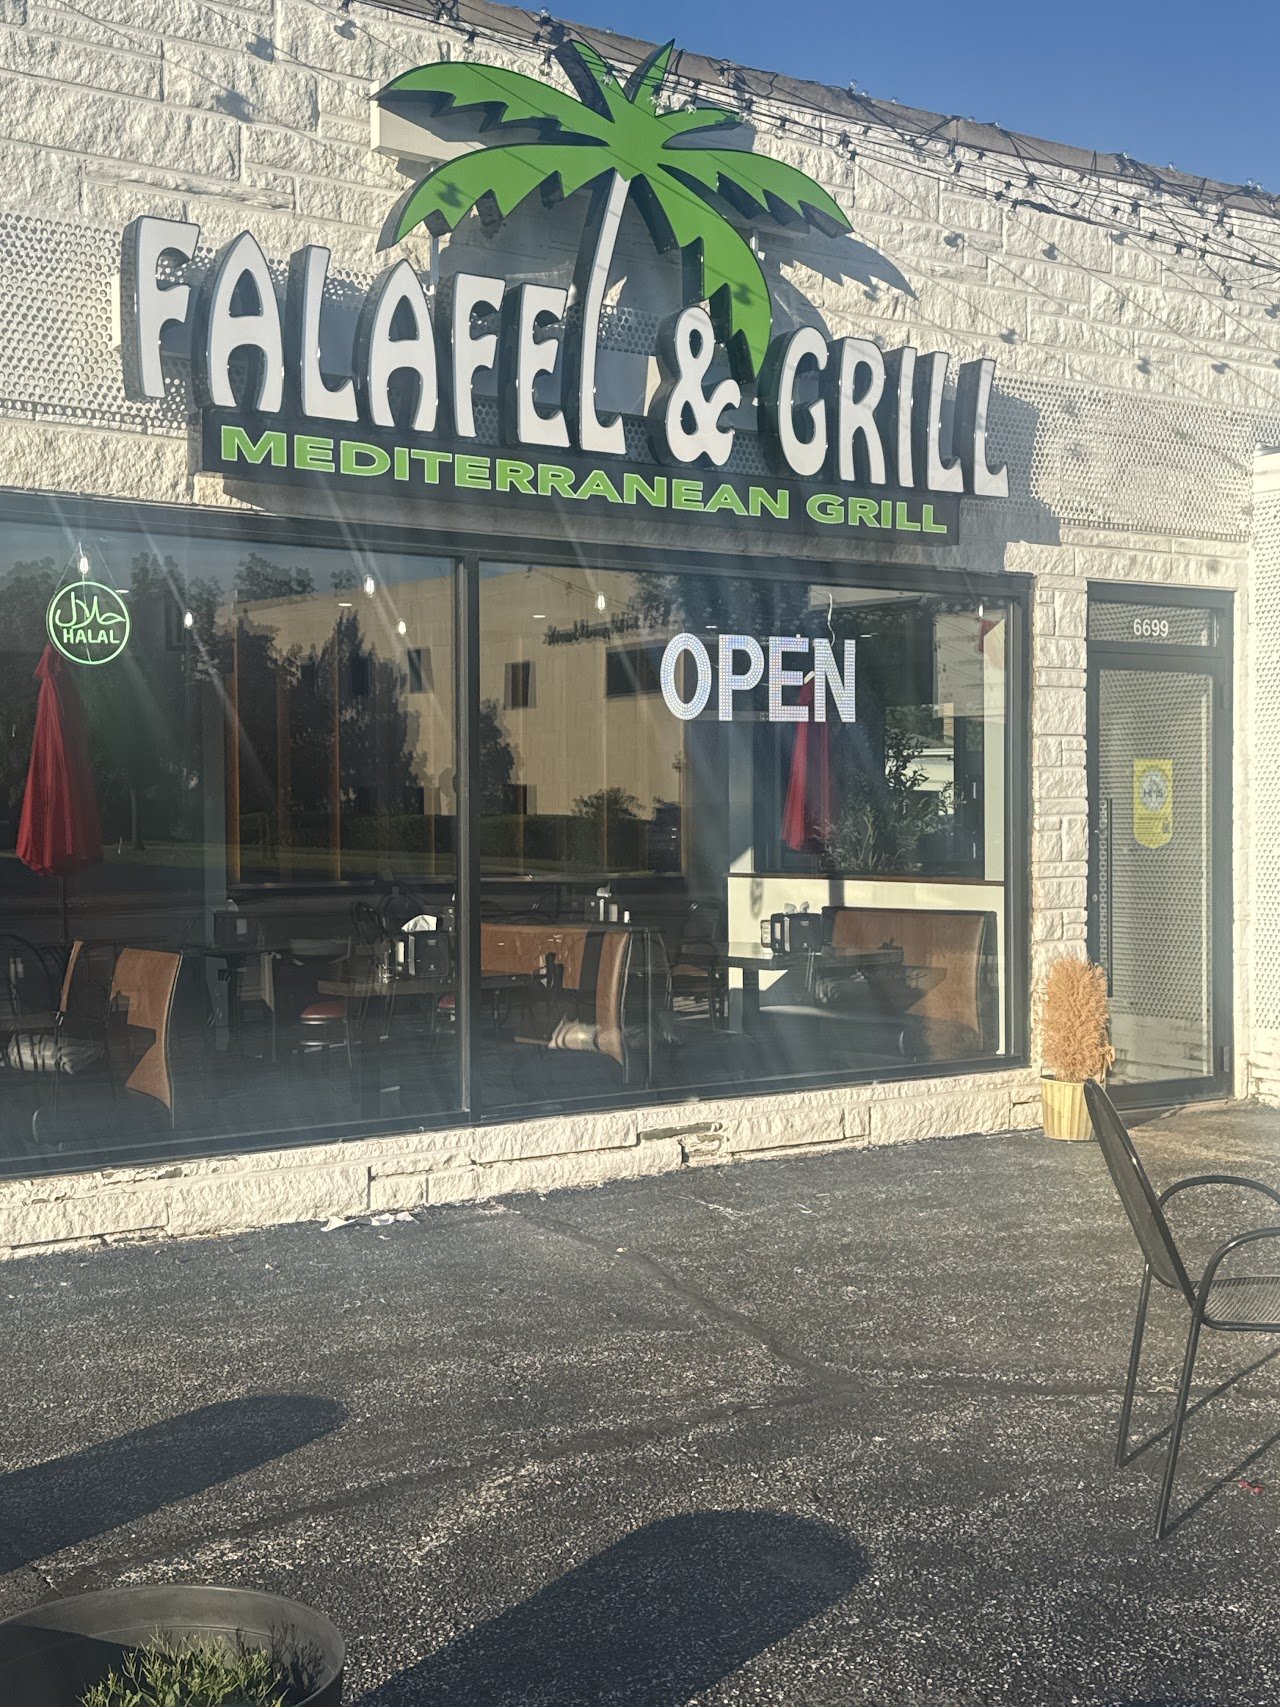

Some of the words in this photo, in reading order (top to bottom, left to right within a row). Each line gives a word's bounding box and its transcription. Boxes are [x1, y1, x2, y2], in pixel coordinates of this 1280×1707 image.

[134, 170, 627, 455] FALAFEL
[666, 306, 741, 467] &
[777, 326, 1009, 498] GRILL
[220, 424, 790, 520] MEDITERRANEAN
[805, 493, 948, 534] GRILL
[55, 591, 127, 630] حلال
[63, 628, 120, 644] HALAL
[1133, 618, 1169, 637] 6699
[660, 632, 856, 722] OPEN
